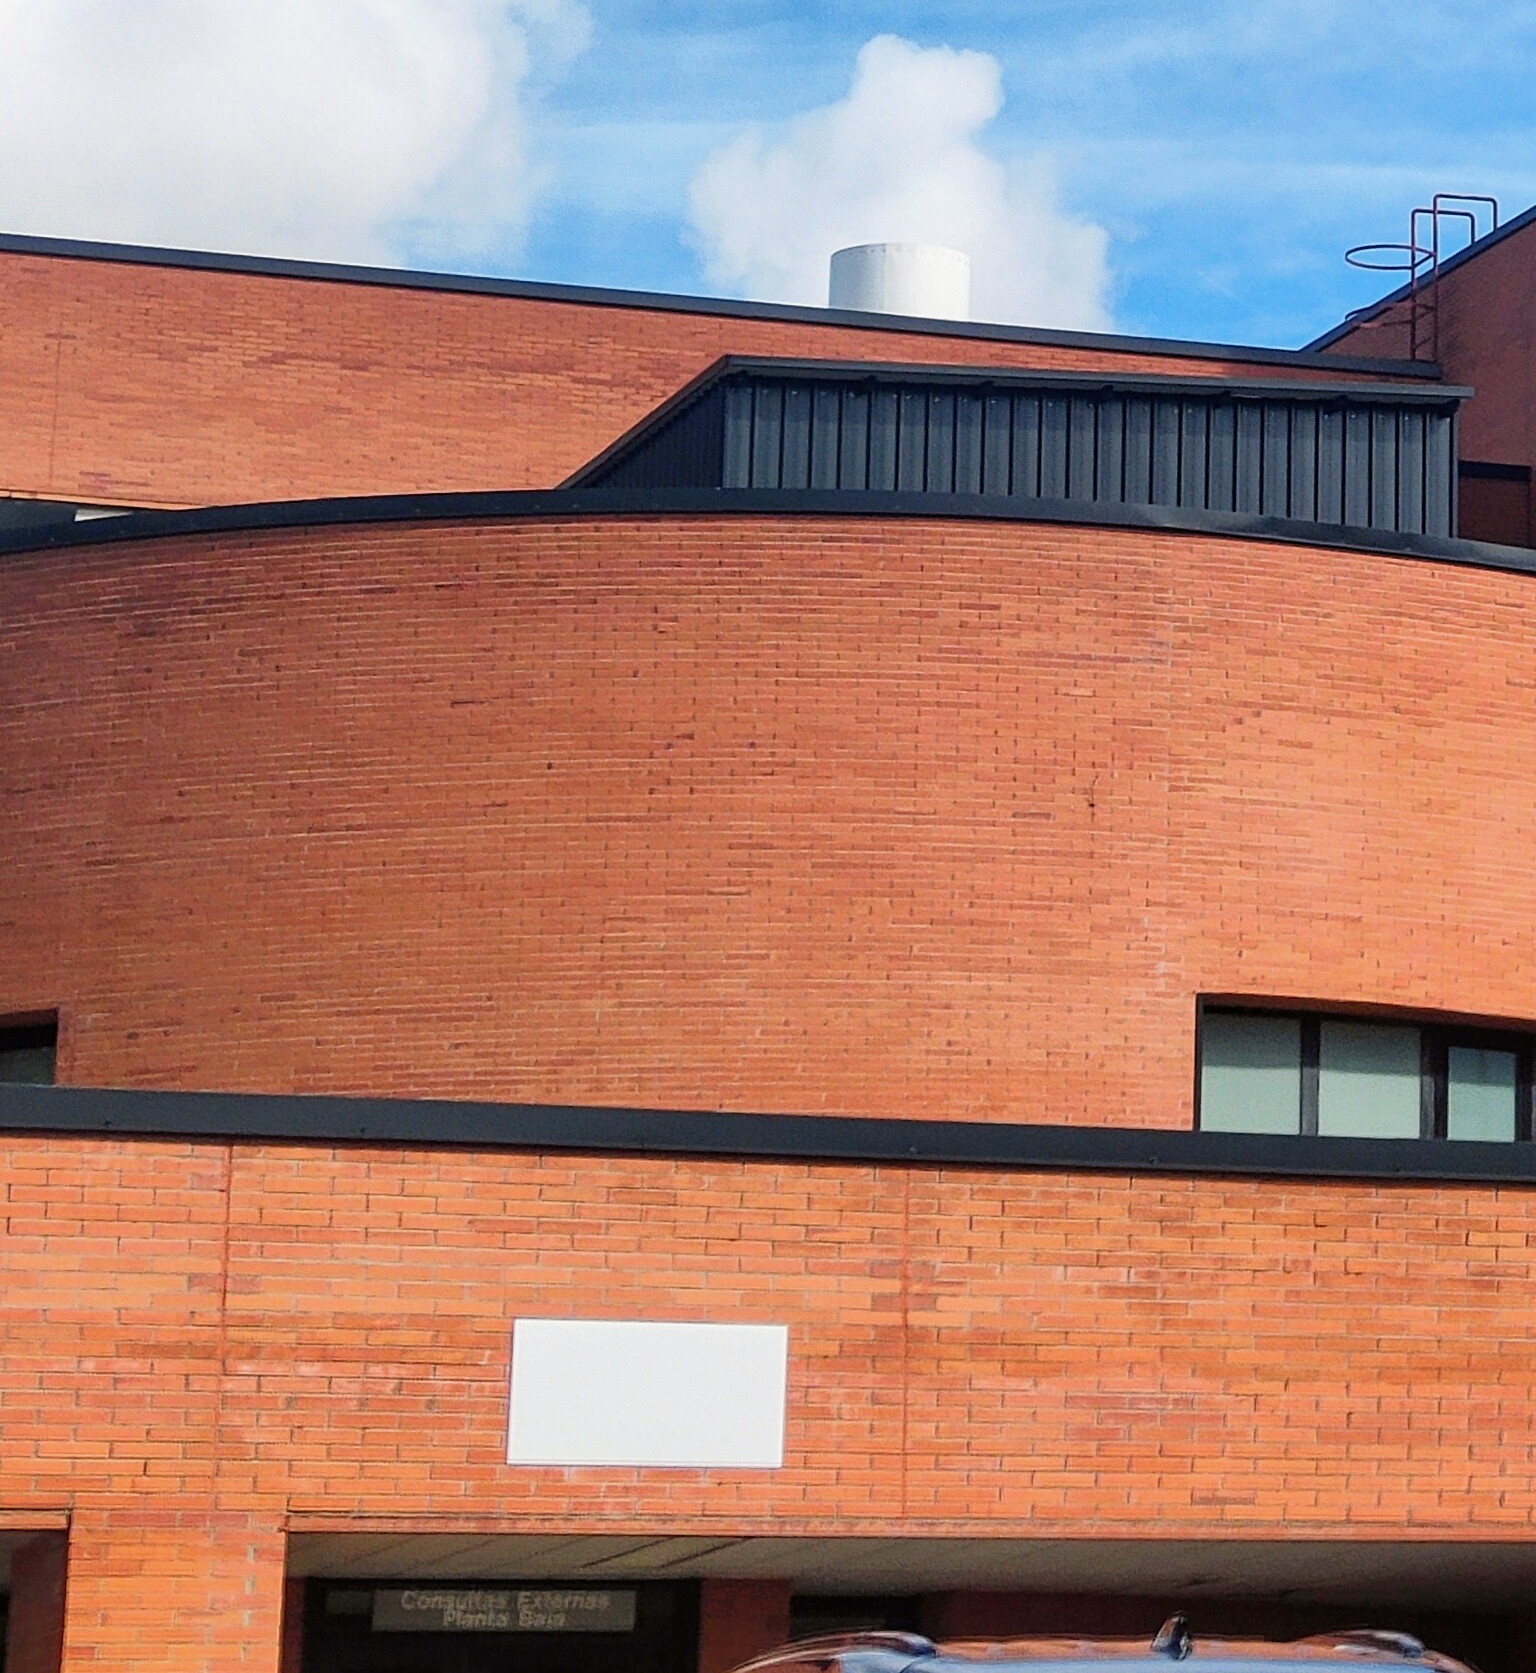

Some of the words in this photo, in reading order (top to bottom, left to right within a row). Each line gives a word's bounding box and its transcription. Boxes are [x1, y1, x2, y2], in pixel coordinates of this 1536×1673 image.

[400, 1590, 507, 1610] Consultas
[517, 1591, 611, 1610] Externas
[443, 1610, 509, 1627] Planta
